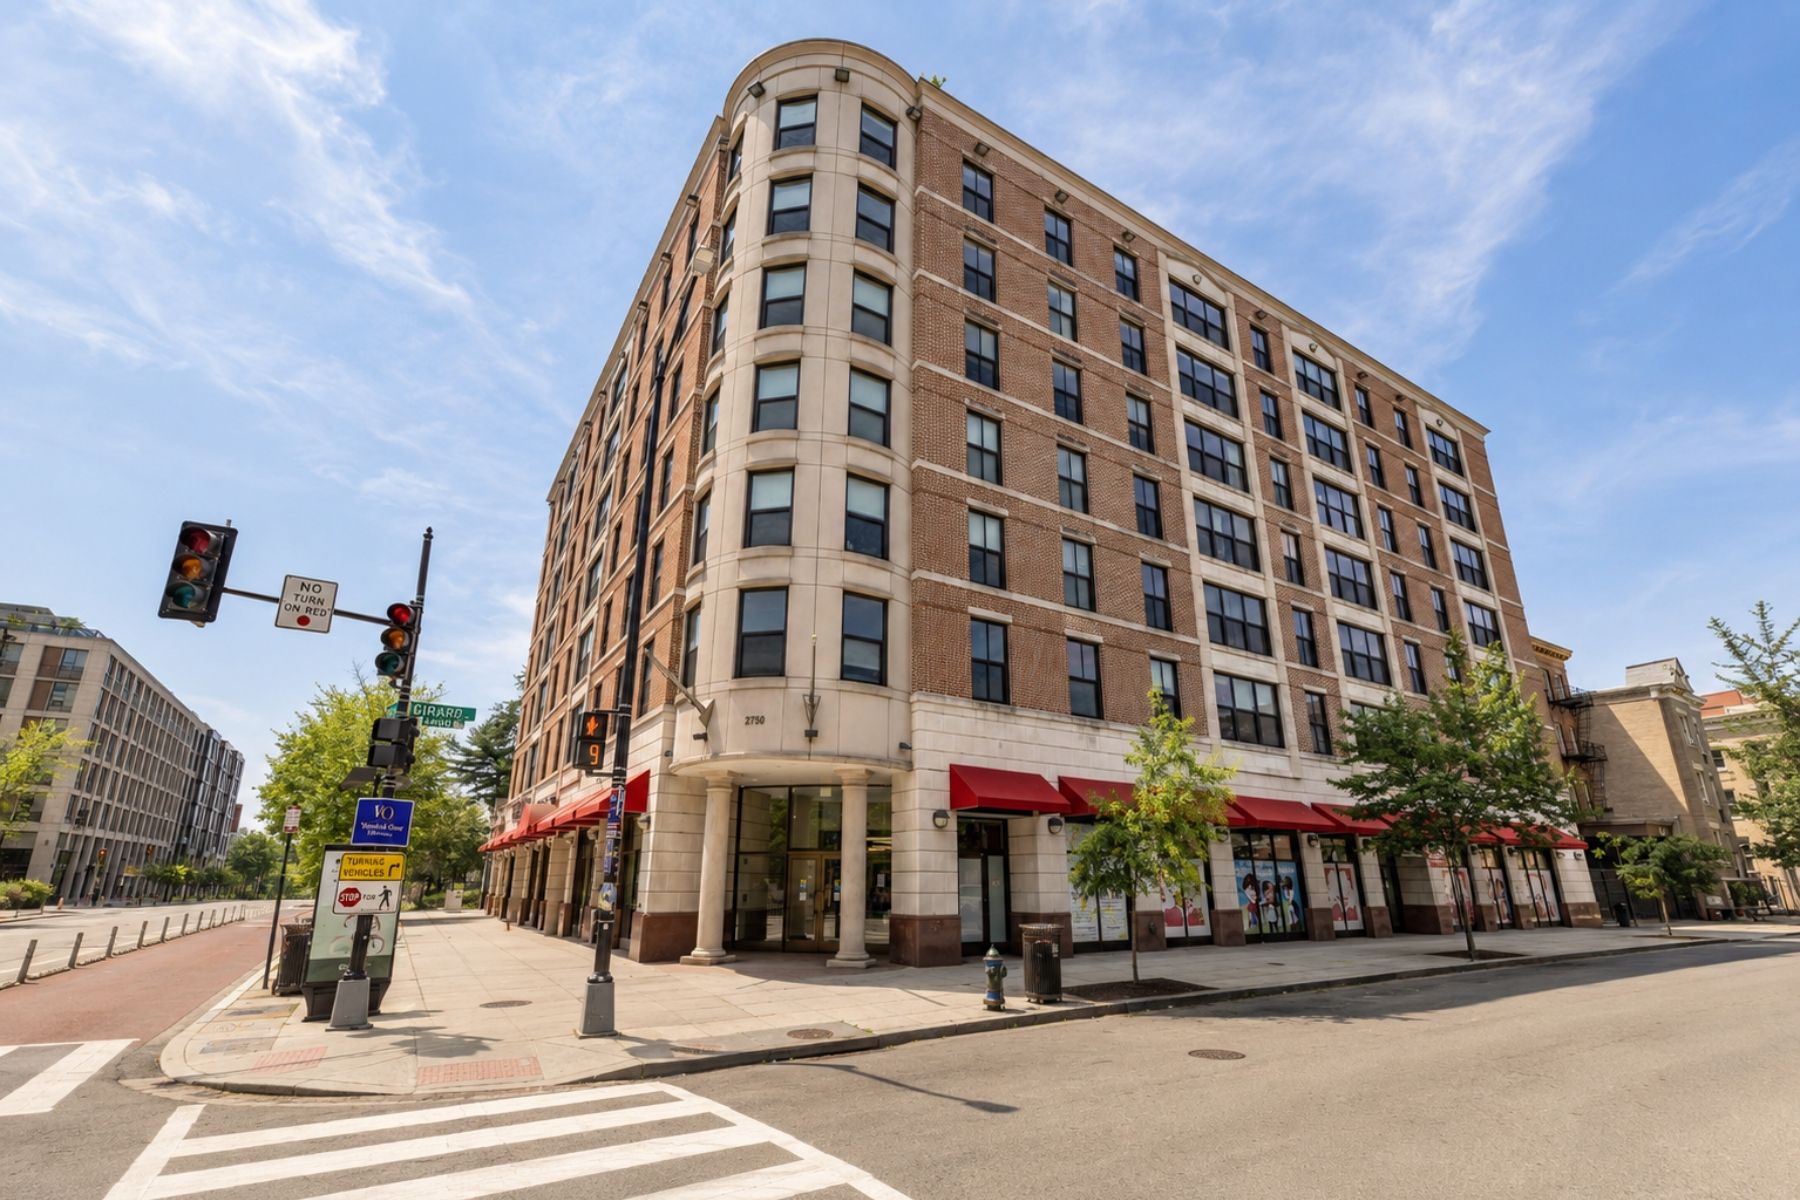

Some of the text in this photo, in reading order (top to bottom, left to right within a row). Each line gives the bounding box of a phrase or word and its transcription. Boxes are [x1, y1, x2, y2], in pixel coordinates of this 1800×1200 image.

[300, 582, 322, 593] NO
[294, 593, 325, 605] TURN
[284, 603, 327, 617] ON RED
[413, 703, 463, 719] GIRARD
[590, 744, 599, 765] 9
[347, 857, 385, 866] TURNING
[343, 868, 385, 877] VEHICLES
[339, 893, 360, 902] STOP
